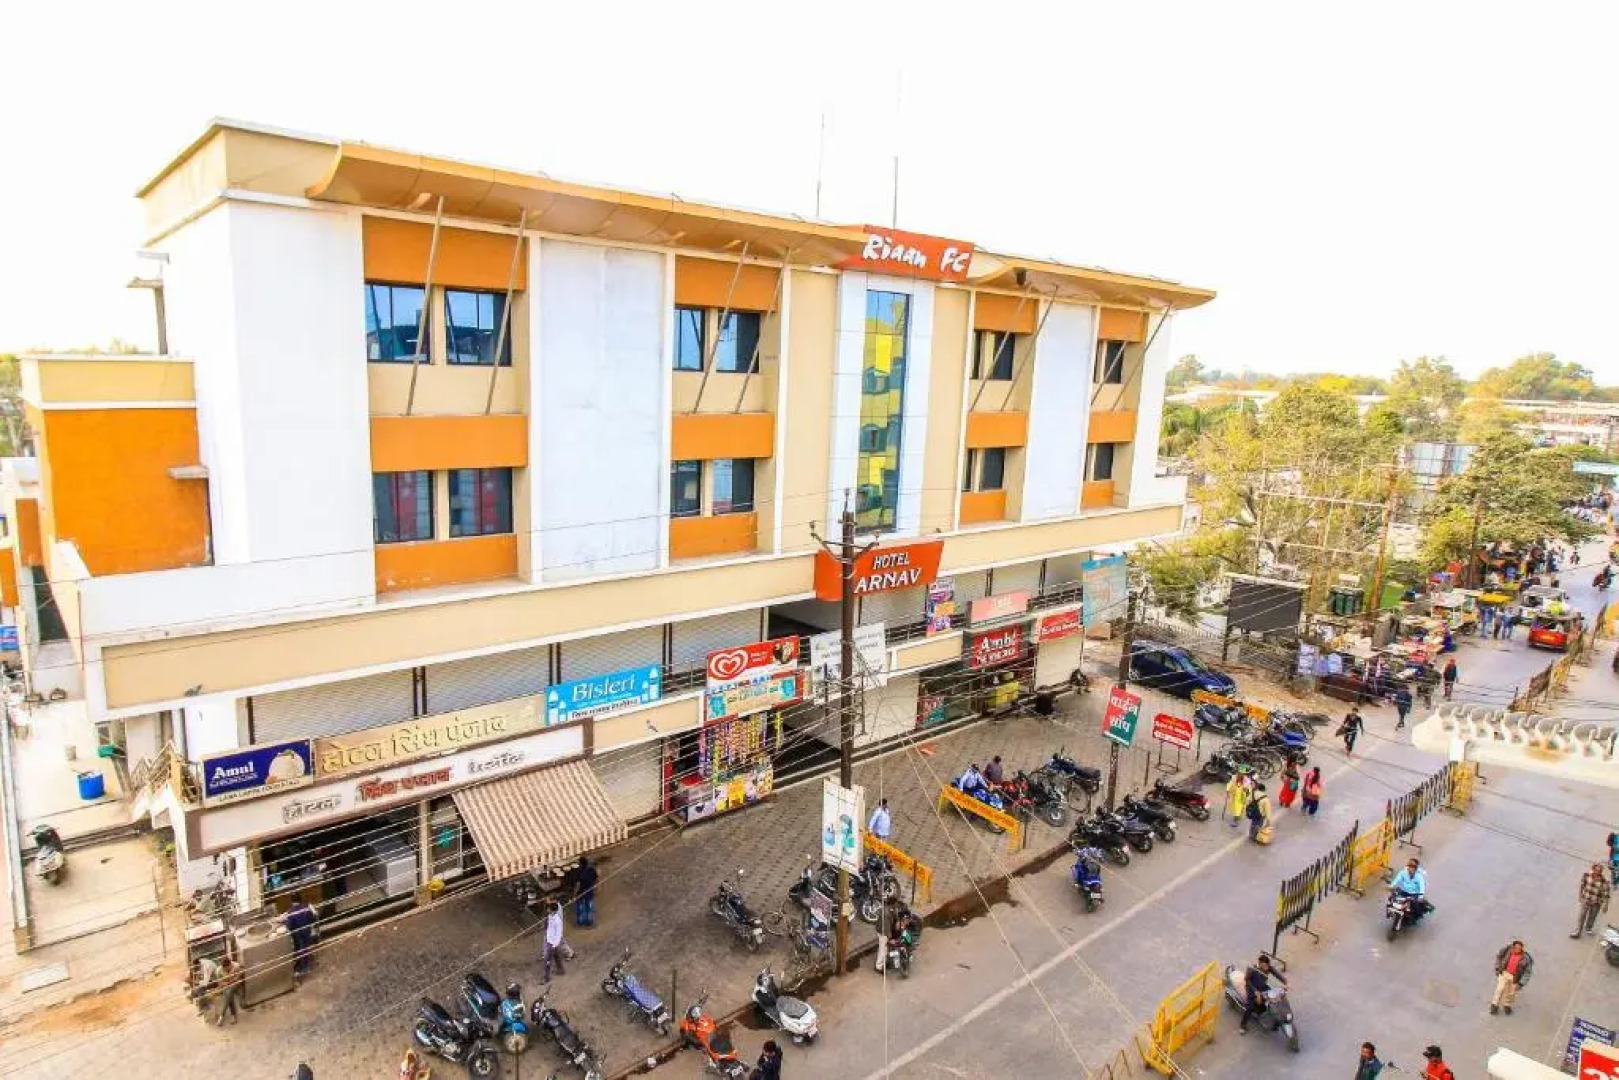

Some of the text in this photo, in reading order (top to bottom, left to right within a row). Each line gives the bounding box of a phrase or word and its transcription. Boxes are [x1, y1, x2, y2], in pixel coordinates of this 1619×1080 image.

[872, 551, 910, 570] HOTEL
[853, 567, 922, 594] ARNAV
[573, 673, 636, 702] Bisleri
[322, 739, 387, 773] होटल
[445, 714, 509, 743] पंजाब
[214, 761, 254, 779] Amul
